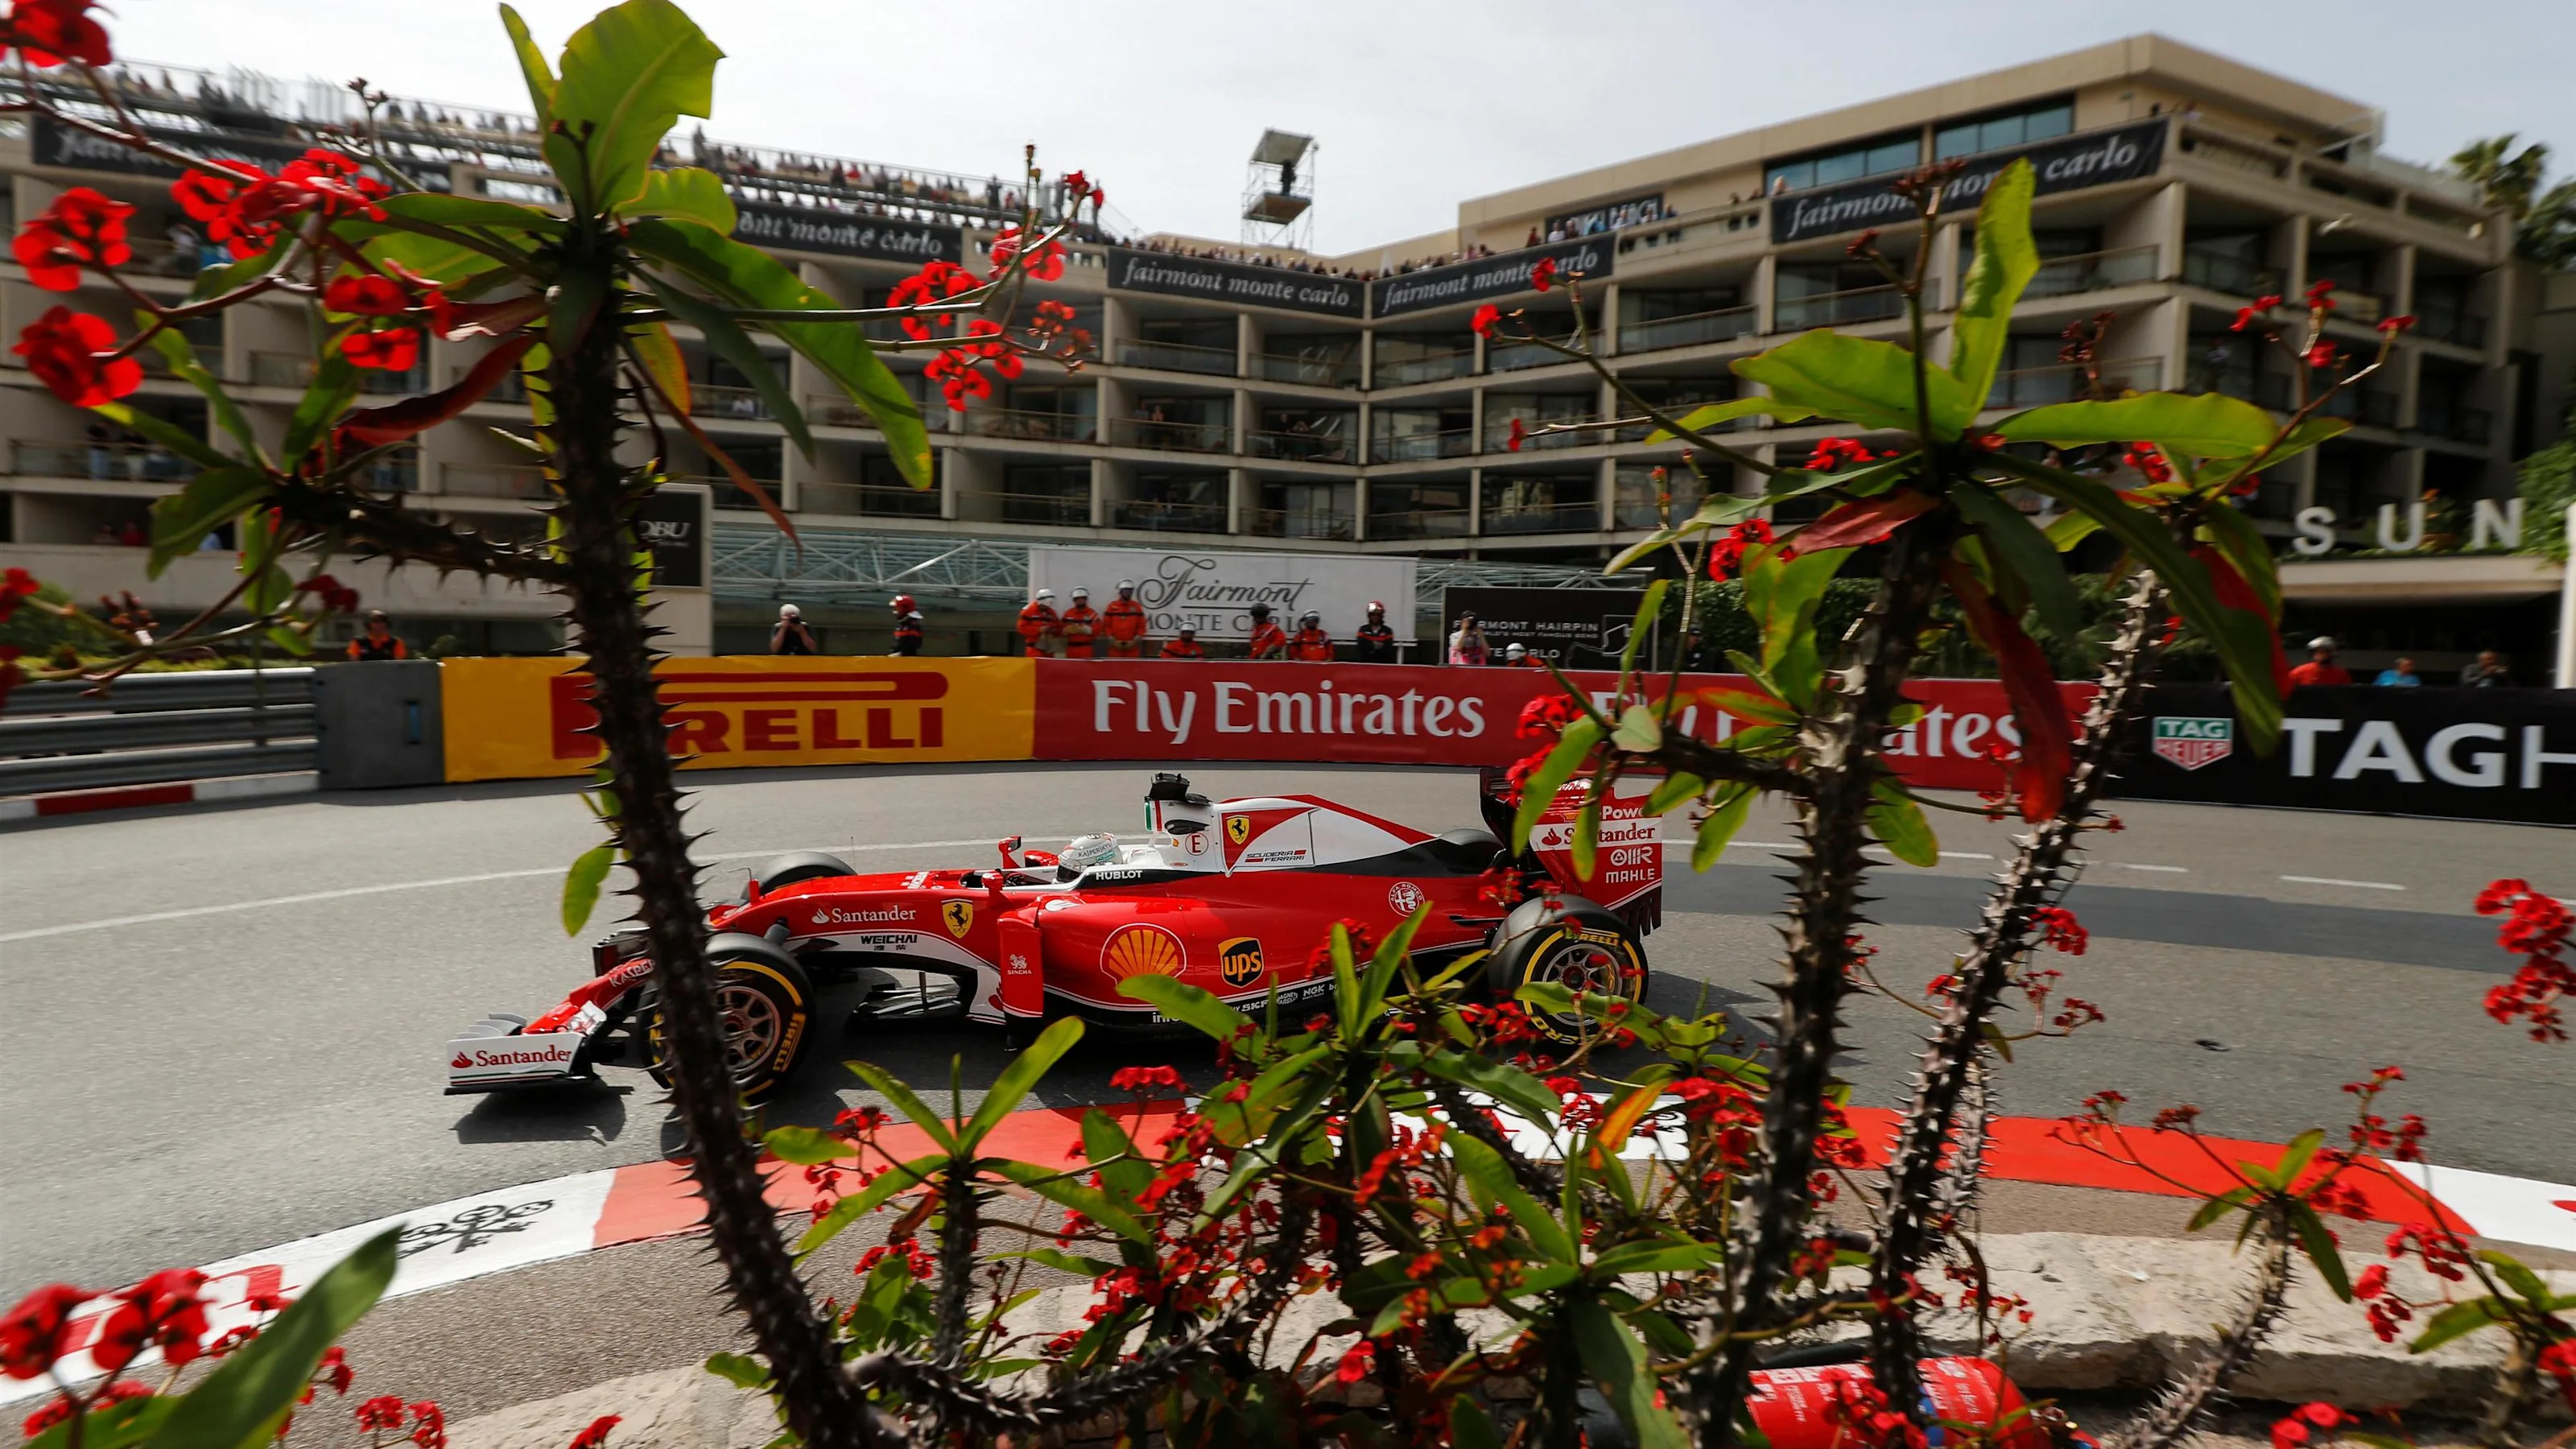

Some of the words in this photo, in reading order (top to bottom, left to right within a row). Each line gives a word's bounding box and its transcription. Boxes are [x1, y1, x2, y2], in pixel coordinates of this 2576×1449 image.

[1788, 193, 1915, 237] fairmon
[2045, 135, 2137, 181] carlo
[1122, 257, 1222, 292] fairmont
[1228, 276, 1294, 299] monte
[1298, 284, 1349, 306] carlo
[1382, 275, 1468, 313] fairmont
[1555, 245, 1598, 275] arlo
[639, 520, 691, 539] OBU
[1136, 555, 1314, 611] Fairmont
[1452, 620, 1529, 631] FRMONT
[1535, 621, 1599, 631] HAIRPIN
[1530, 649, 1560, 658] RLO
[550, 671, 949, 760] PRELLI
[1092, 679, 1196, 745] Fly
[1212, 679, 1486, 737] Emirates
[2161, 720, 2225, 738] TAG
[2156, 740, 2228, 764] HEUER
[1564, 823, 1655, 844] Stander
[1247, 850, 1294, 859] SCUDERIA
[1096, 870, 1143, 881] HUBLOT
[1606, 869, 1655, 883] MAHLE
[1402, 883, 1422, 901] ROMEO
[832, 905, 916, 923] Santander
[861, 935, 917, 944] WEICHAI
[1224, 952, 1261, 982] ups
[1303, 984, 1325, 997] NGK
[476, 1045, 572, 1067] Santander
